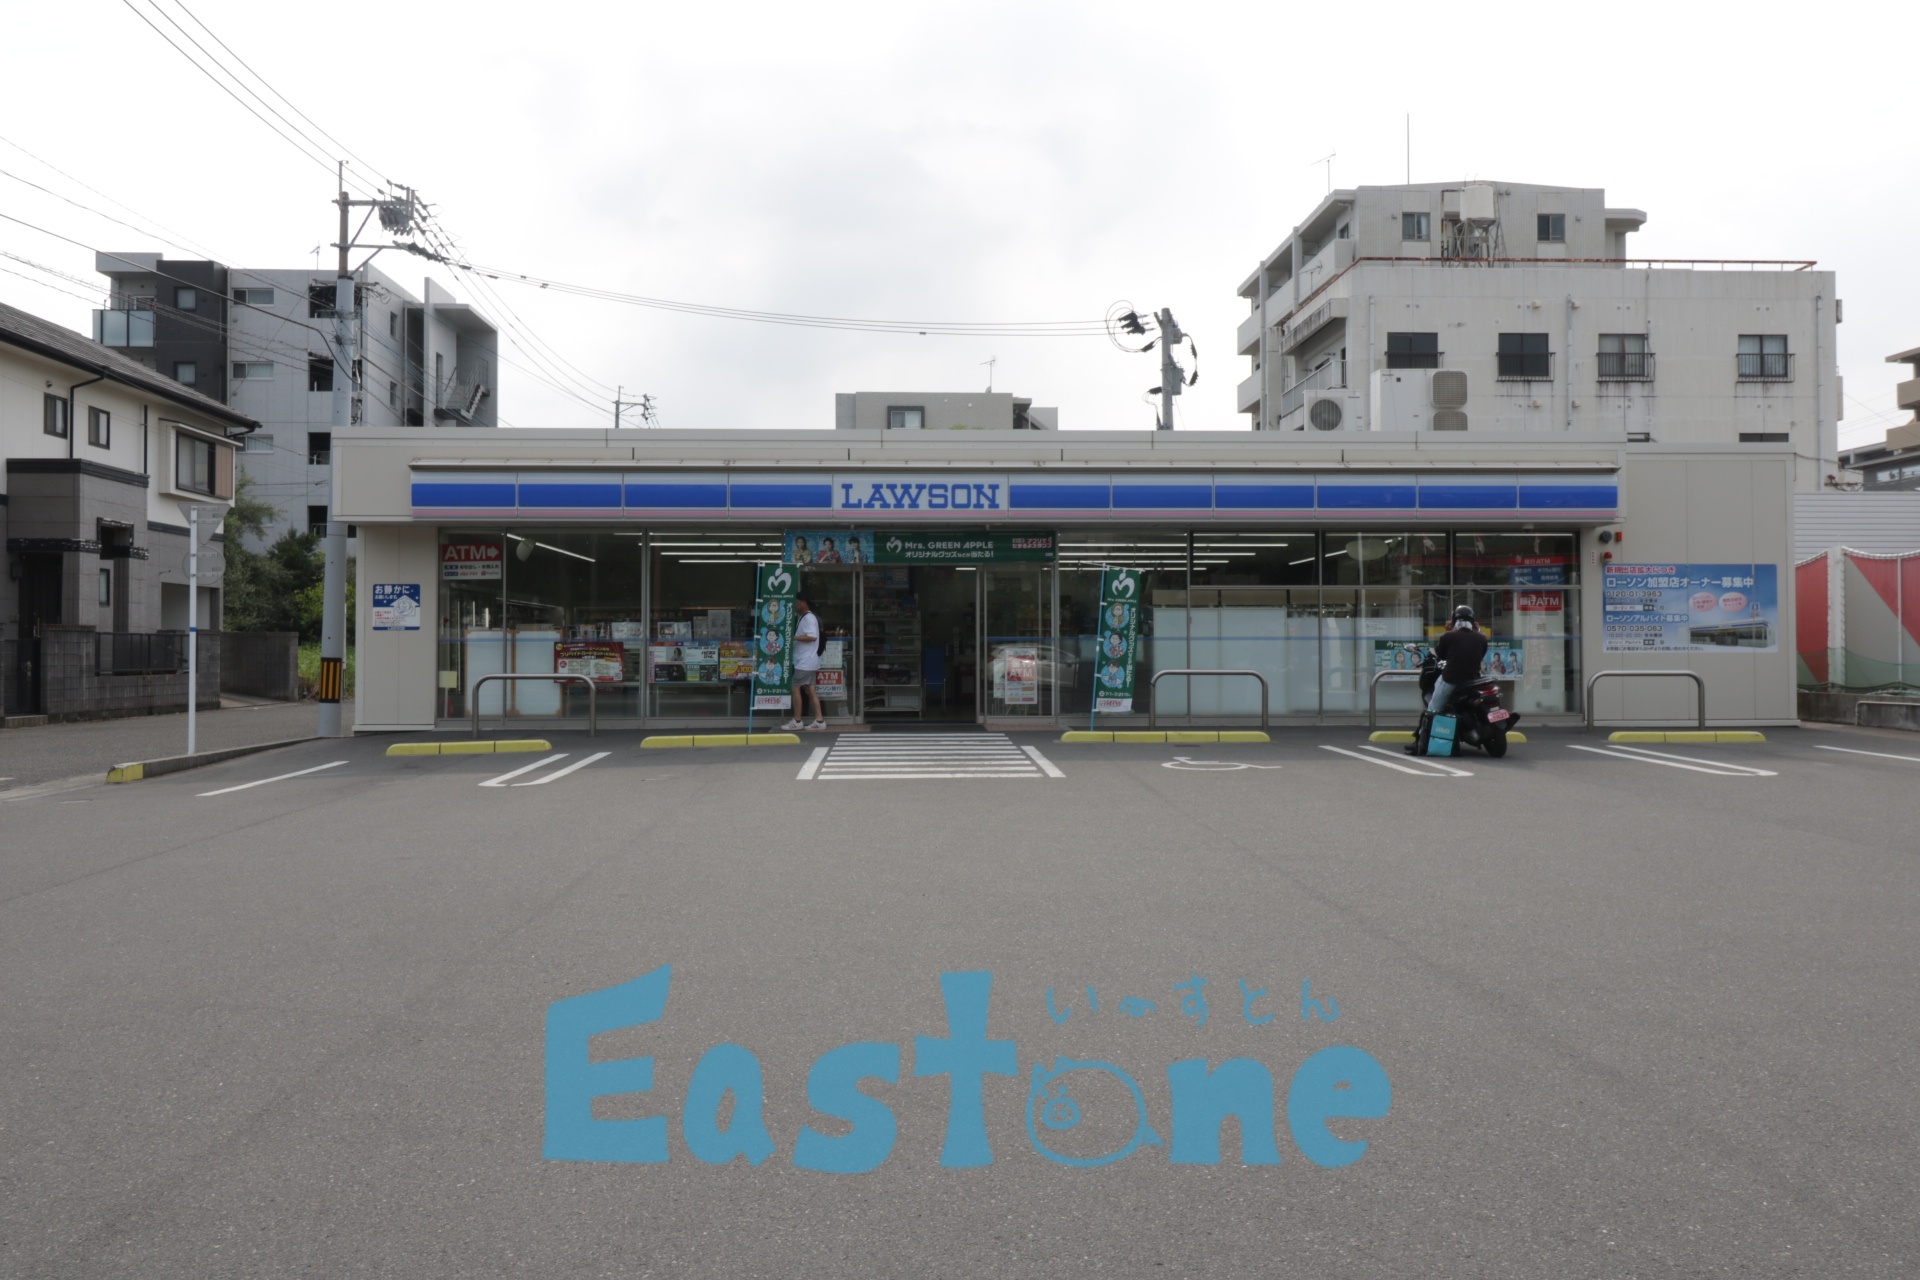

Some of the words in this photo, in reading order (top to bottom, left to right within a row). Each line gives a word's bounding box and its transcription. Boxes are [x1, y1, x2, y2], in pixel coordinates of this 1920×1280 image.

[841, 484, 999, 508] LAWSON
[444, 545, 486, 560] ATM
[1606, 566, 1675, 574] 新規出店拡大につき
[1606, 577, 1754, 588] ローソン加盟店オーナー募集中
[375, 585, 410, 595] お静かに
[817, 672, 838, 680] ATM
[1010, 669, 1032, 677] ATM
